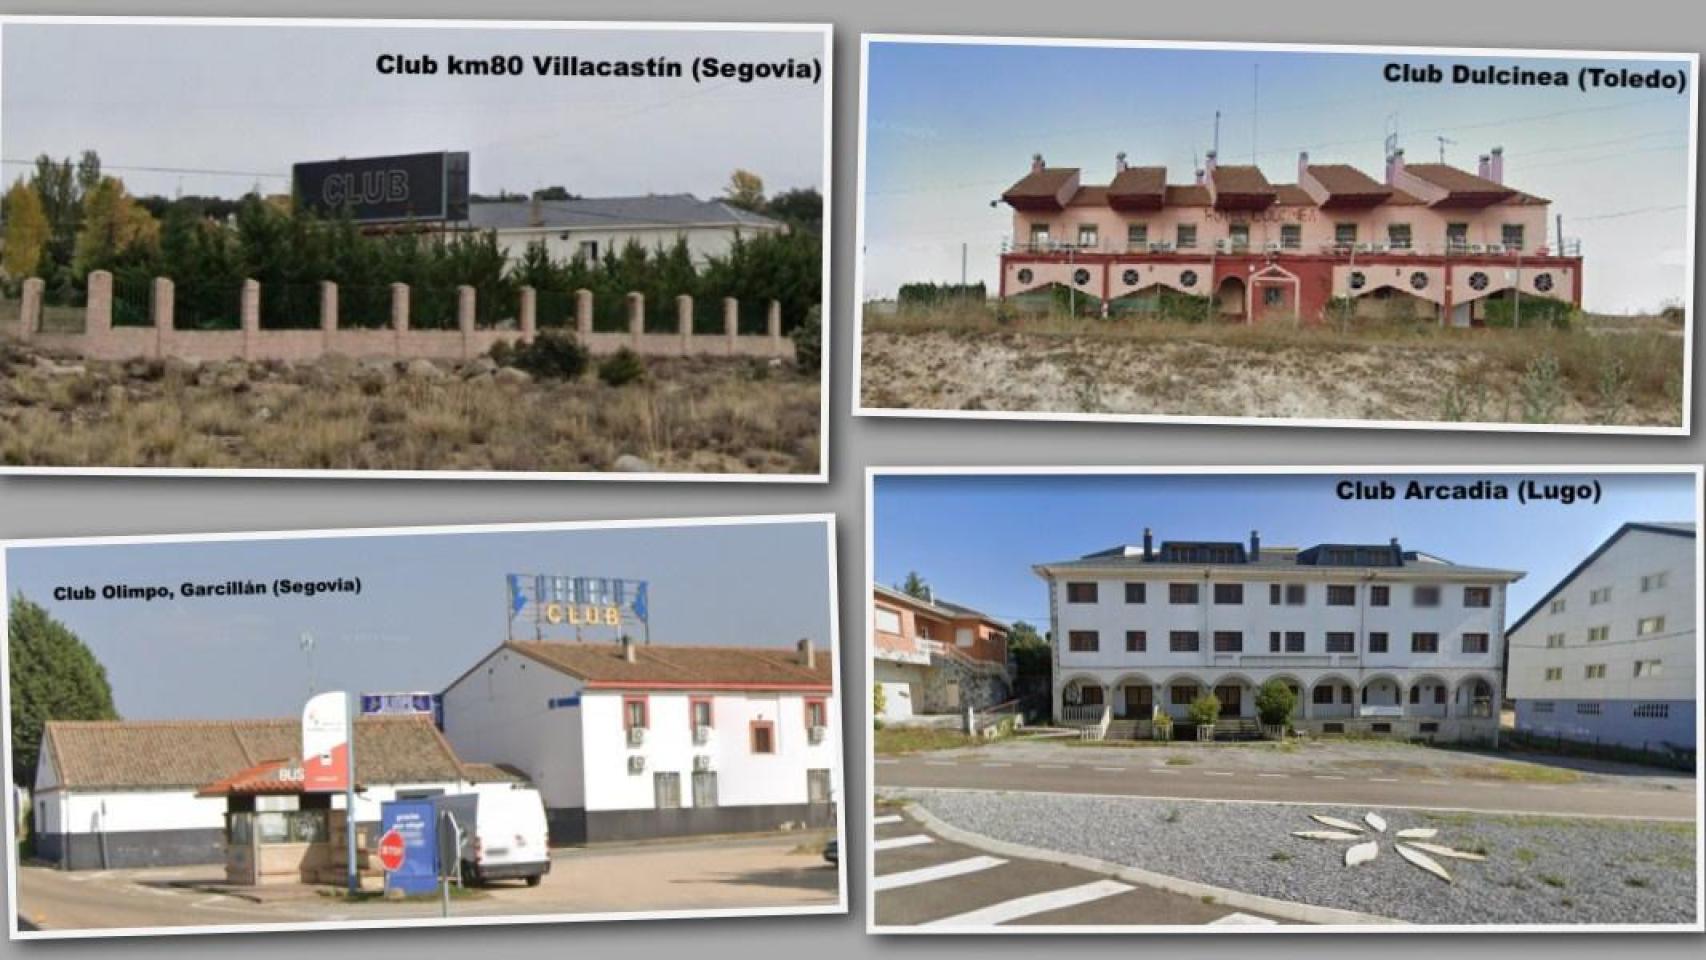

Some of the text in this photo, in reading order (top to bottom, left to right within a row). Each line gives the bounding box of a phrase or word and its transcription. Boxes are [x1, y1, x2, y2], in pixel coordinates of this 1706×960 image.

[322, 169, 409, 206] CLUB
[547, 603, 619, 625] CLUB
[279, 767, 305, 782] BUS
